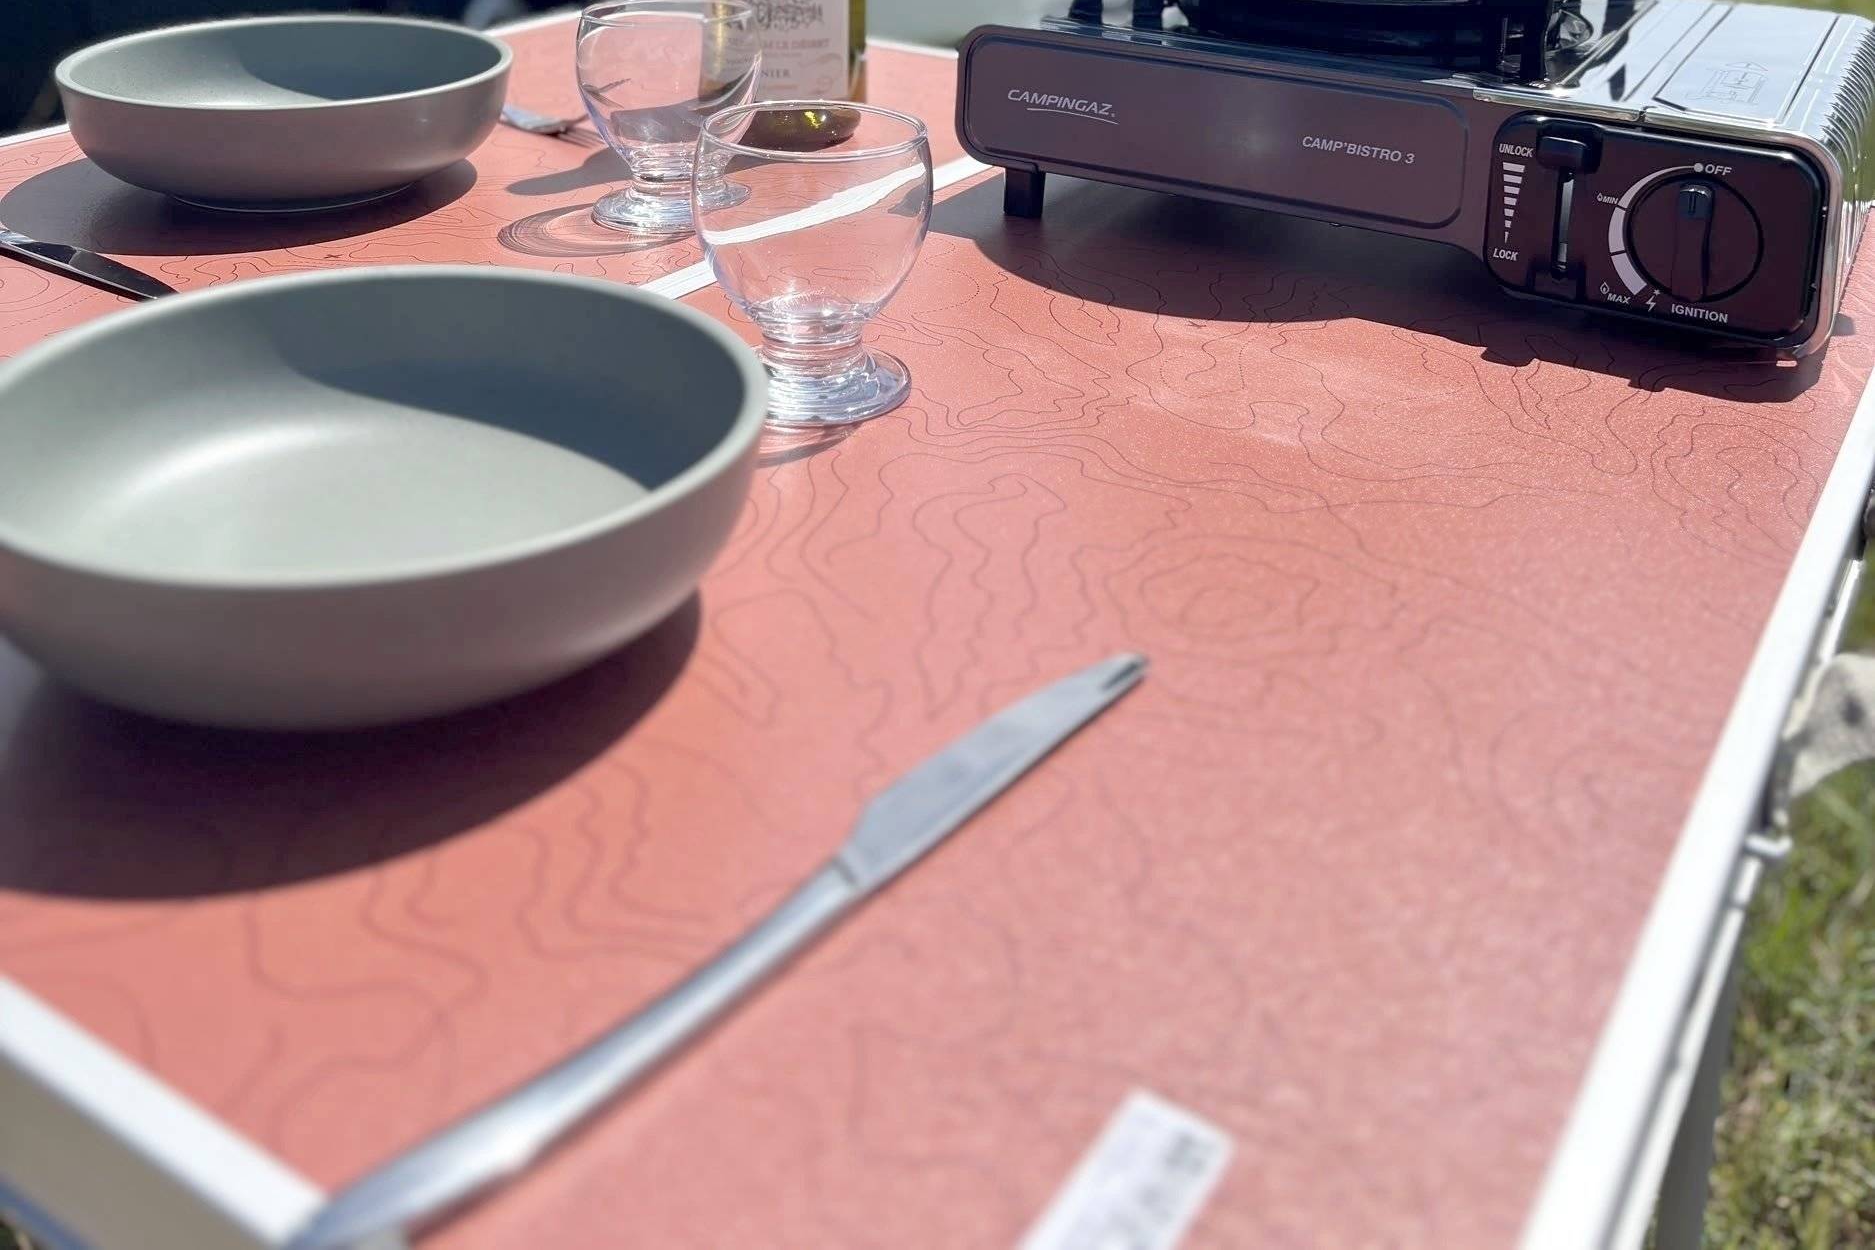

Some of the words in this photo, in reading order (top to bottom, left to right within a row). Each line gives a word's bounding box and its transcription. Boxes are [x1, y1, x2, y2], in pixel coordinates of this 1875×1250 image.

[1007, 89, 1113, 116] CAMPINGAZ
[1302, 136, 1402, 162] CAMP'BISTRO
[1405, 153, 1416, 164] 3
[1498, 143, 1534, 158] UNLOCK
[1705, 163, 1732, 177] OFF
[1602, 195, 1619, 205] MIN
[1492, 248, 1519, 262] LOCK
[1606, 292, 1632, 306] MAX
[1671, 303, 1729, 324] IGNITION
